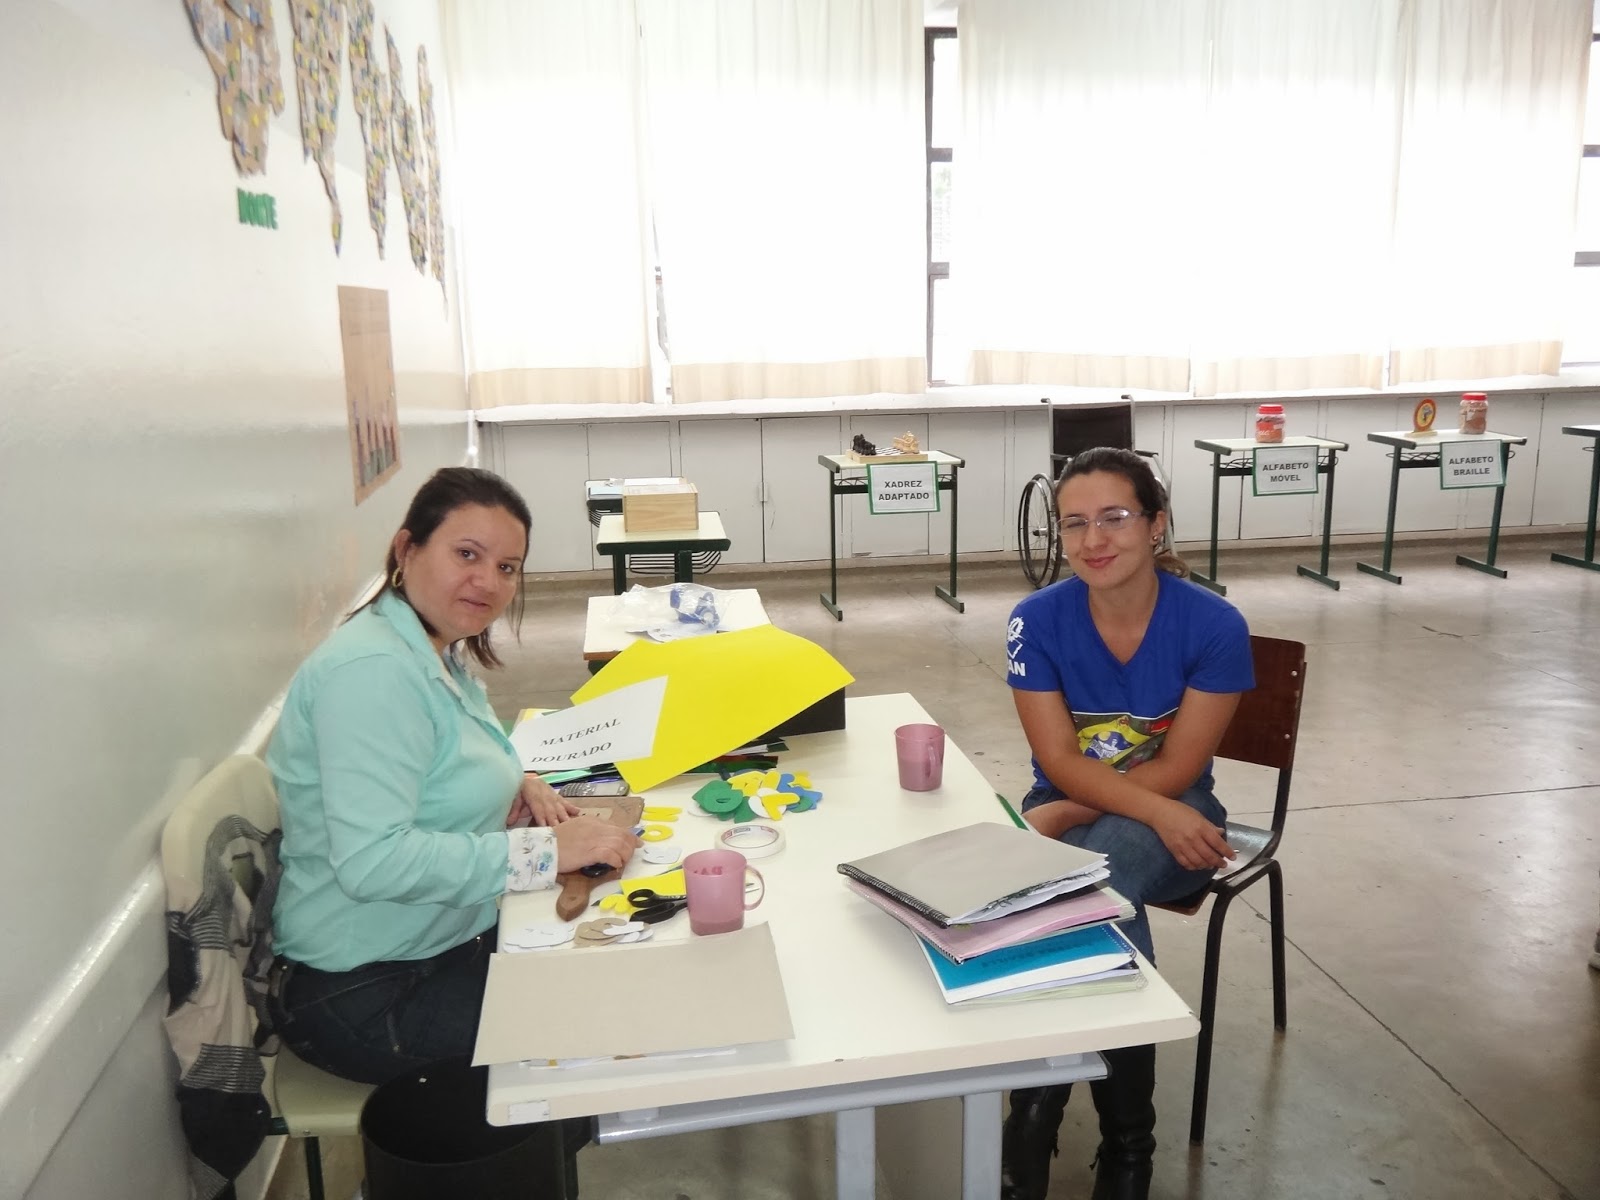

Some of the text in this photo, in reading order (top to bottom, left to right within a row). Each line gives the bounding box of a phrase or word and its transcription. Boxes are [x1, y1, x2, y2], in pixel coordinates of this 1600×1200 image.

[1448, 456, 1494, 466] ALFABETO
[1262, 462, 1310, 472] ALFABETO
[1453, 467, 1491, 477] BRAILLE
[1270, 473, 1302, 483] MÓVEL
[884, 480, 923, 489] XADREZ
[878, 492, 931, 502] ADAPTADO
[540, 718, 622, 747] MATERIAL
[531, 741, 613, 763] DOURADO
